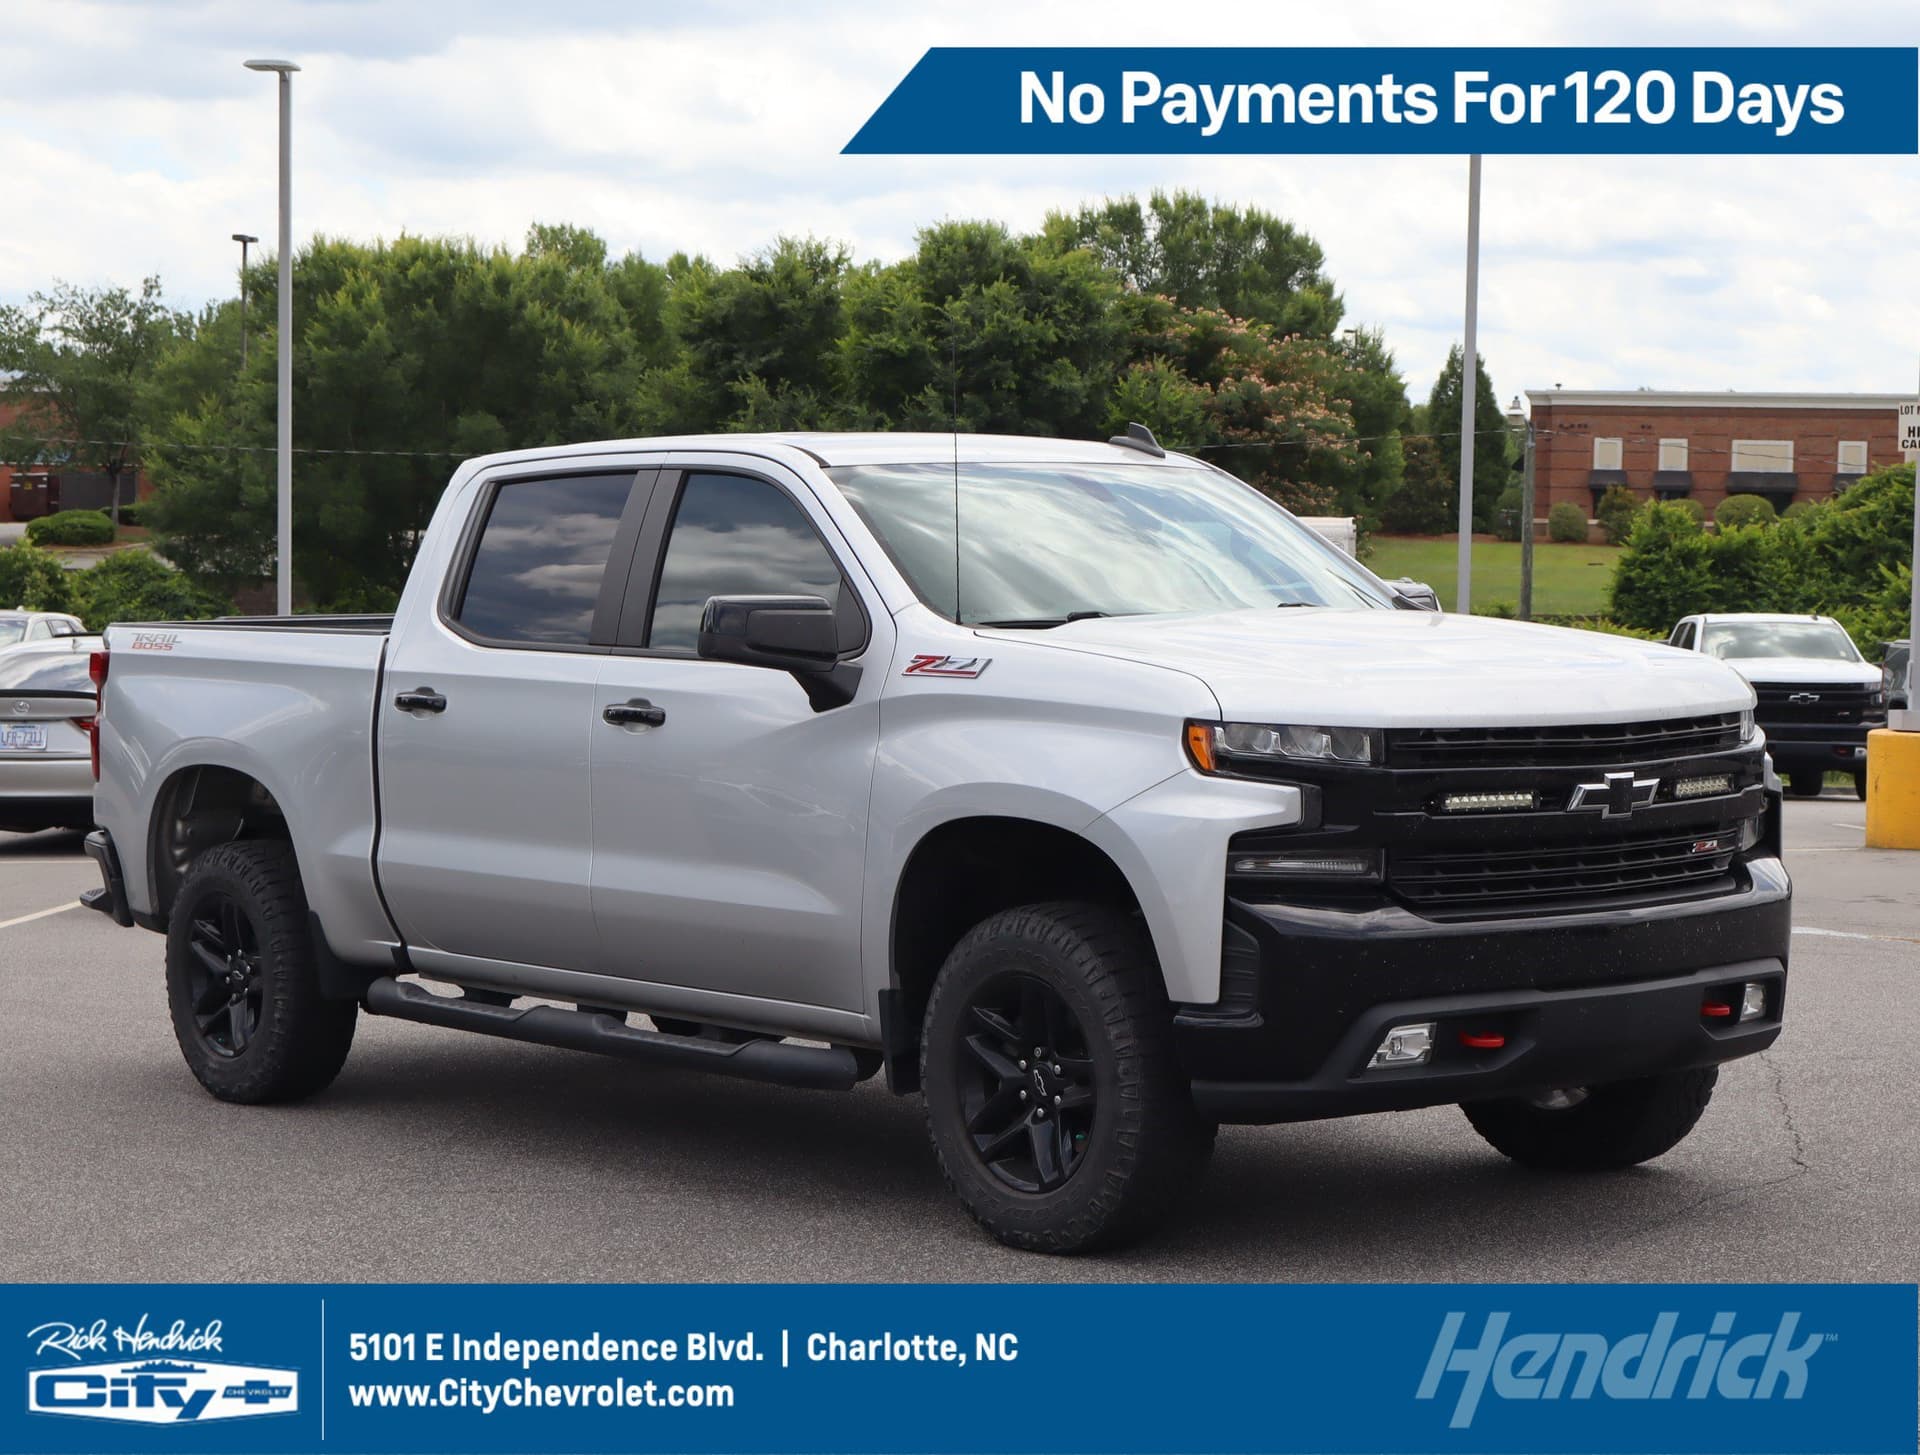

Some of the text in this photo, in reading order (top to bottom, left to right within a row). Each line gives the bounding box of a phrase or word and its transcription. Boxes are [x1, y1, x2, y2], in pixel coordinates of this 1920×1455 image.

[1900, 405, 1914, 416] LOT
[131, 632, 182, 644] TRAIL
[131, 642, 173, 651] BOSS
